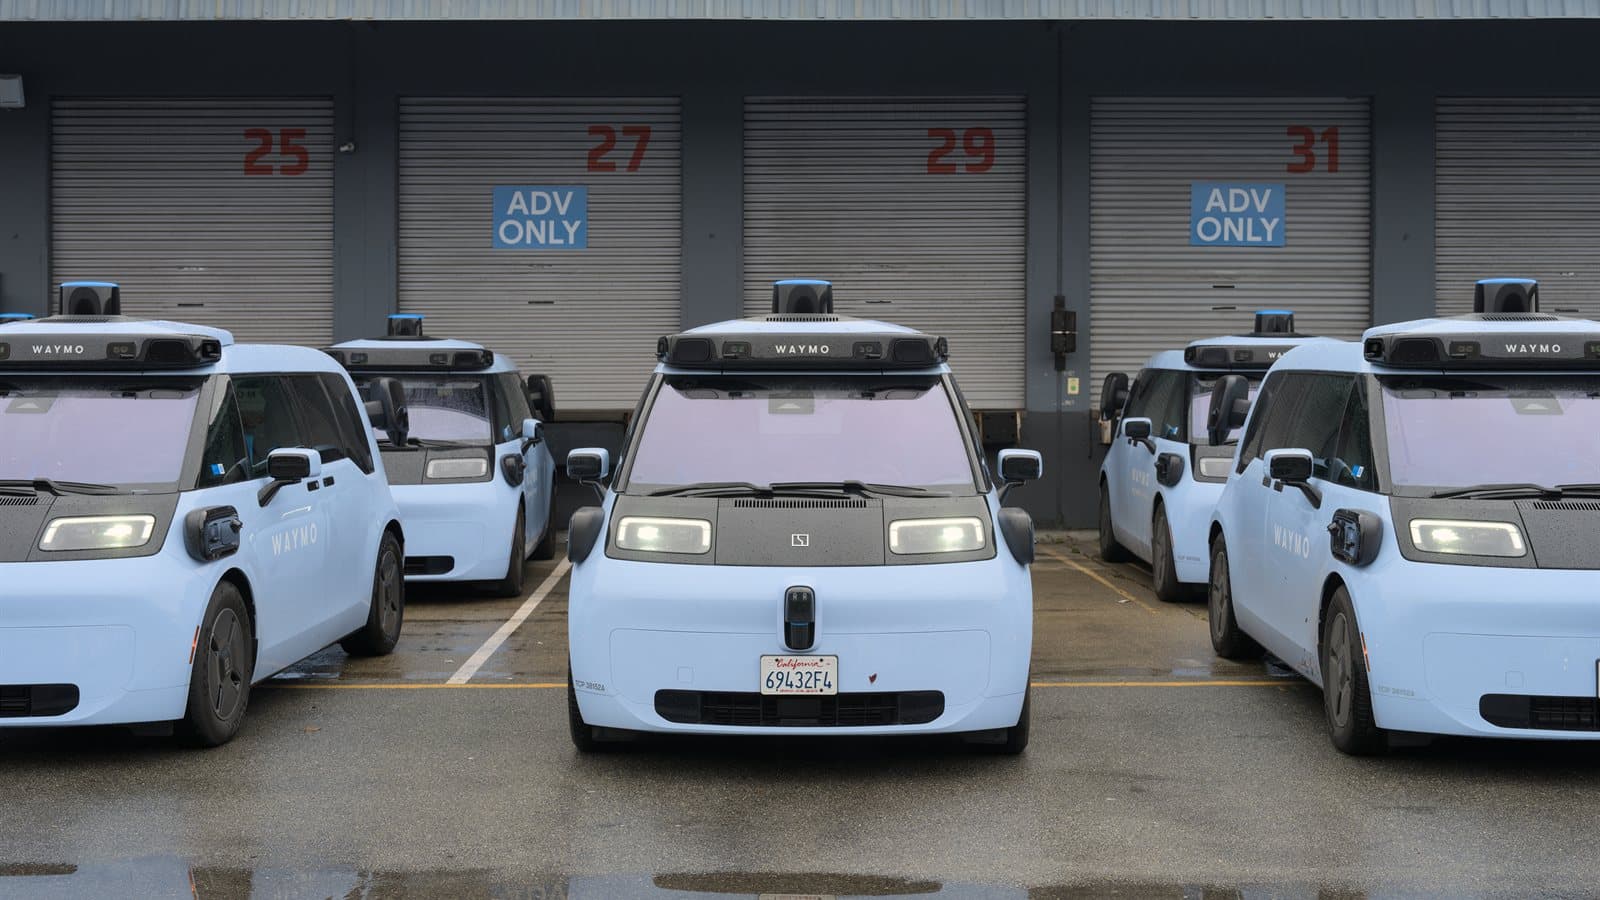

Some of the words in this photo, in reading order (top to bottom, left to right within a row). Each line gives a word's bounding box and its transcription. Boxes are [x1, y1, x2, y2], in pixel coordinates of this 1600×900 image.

[243, 128, 309, 176] 25
[586, 125, 651, 172] 27
[926, 127, 995, 174] 29
[1286, 125, 1339, 173] 31
[507, 191, 573, 215] ADV
[1205, 188, 1271, 212] ADV
[498, 219, 581, 244] ONLY
[1196, 216, 1279, 242] ONLY
[32, 345, 84, 354] WAYMO
[775, 345, 830, 354] WAYMO
[1505, 344, 1561, 353] WAYMO
[271, 522, 317, 556] WAYMO
[1273, 522, 1309, 559] WAYMO
[776, 659, 823, 670] California
[766, 671, 832, 688] 69432F4
